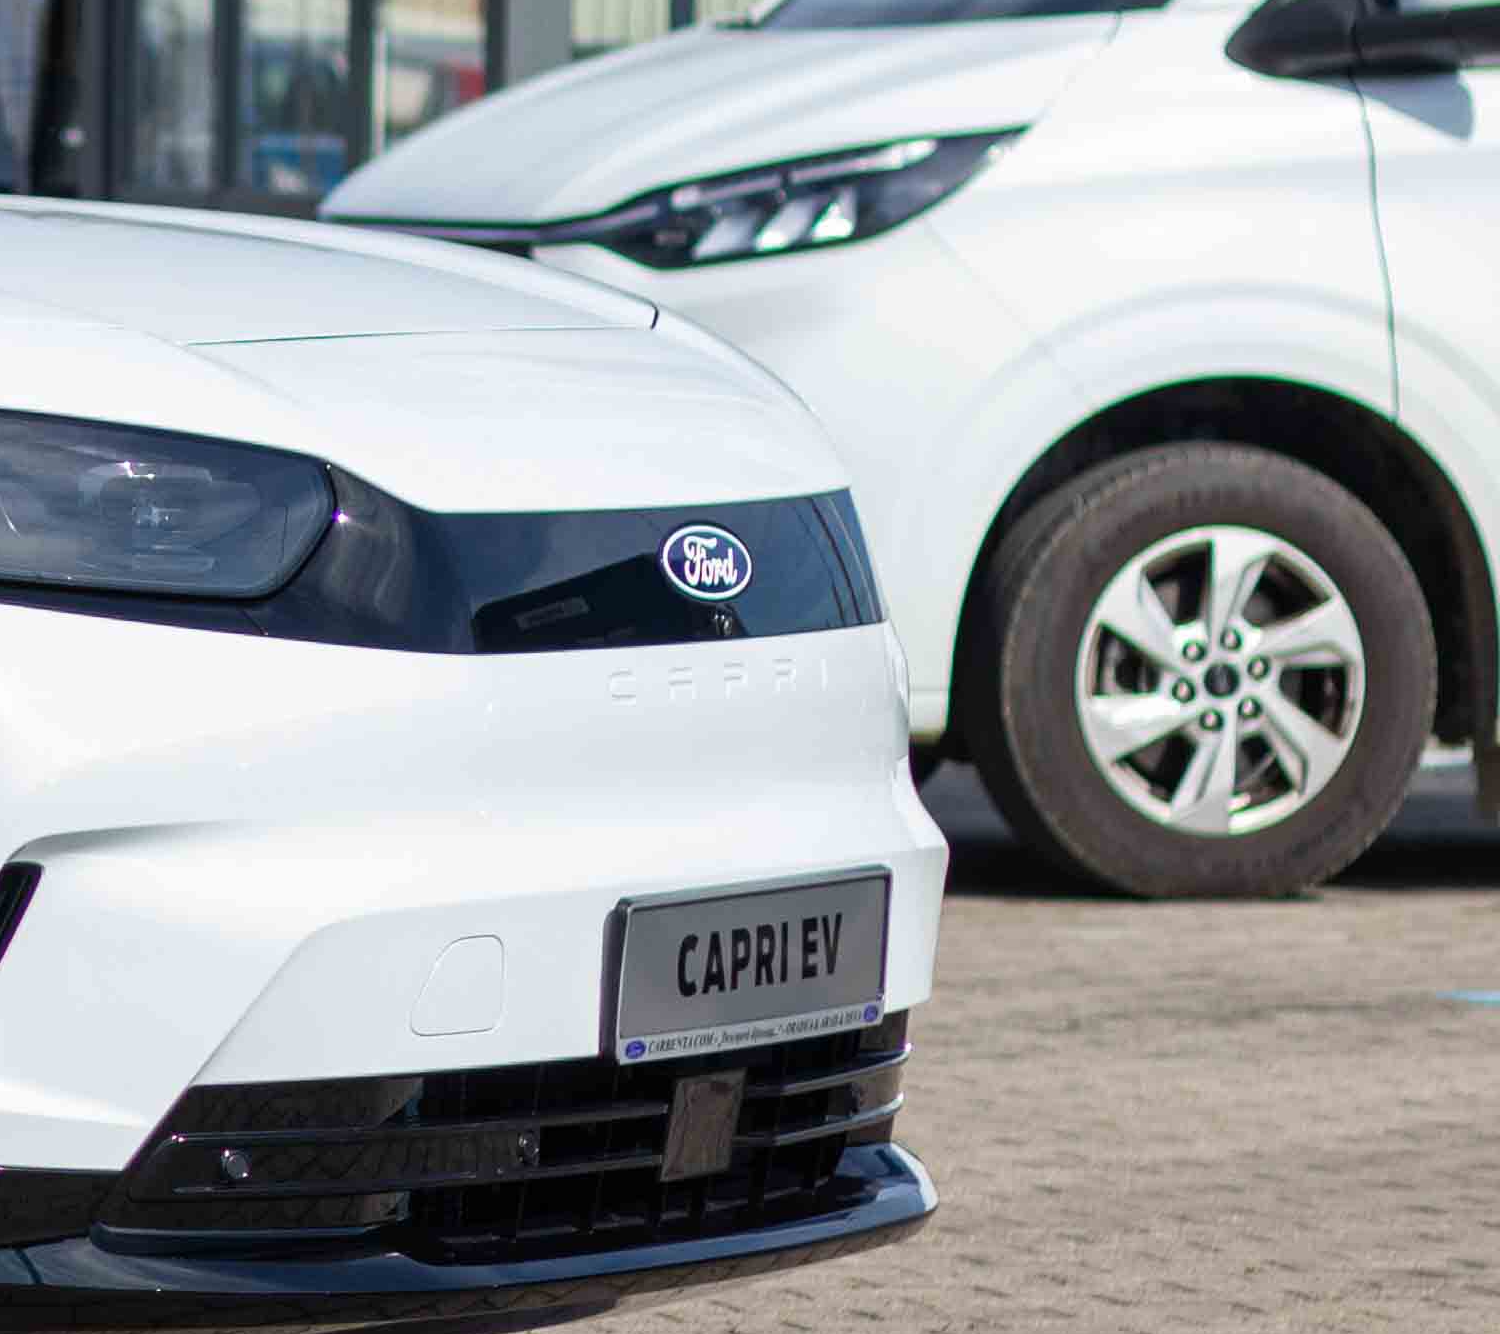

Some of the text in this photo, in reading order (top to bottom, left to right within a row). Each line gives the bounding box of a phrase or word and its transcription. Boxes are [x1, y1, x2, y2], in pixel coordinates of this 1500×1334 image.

[683, 535, 738, 587] Ford
[607, 657, 829, 707] CAPRI
[677, 912, 843, 998] CAPRI EV
